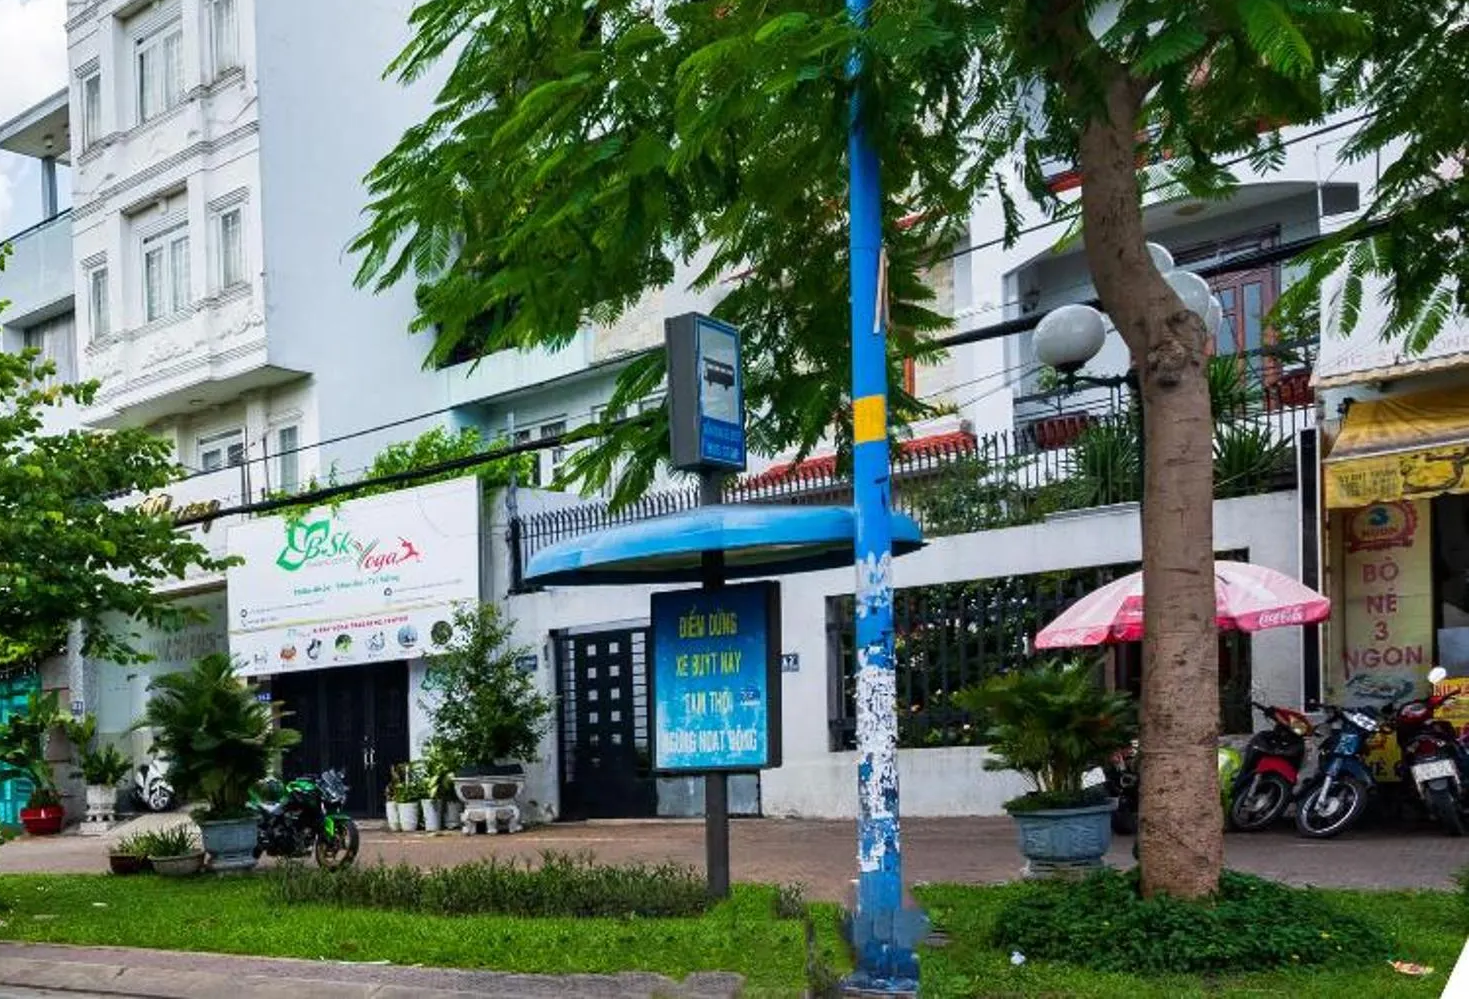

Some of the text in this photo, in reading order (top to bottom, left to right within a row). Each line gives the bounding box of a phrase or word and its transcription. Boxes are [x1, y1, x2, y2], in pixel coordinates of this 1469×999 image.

[1361, 556, 1399, 583] BÒ
[1373, 621, 1390, 641] 3
[675, 654, 689, 677] XE
[1342, 645, 1424, 671] NGON
